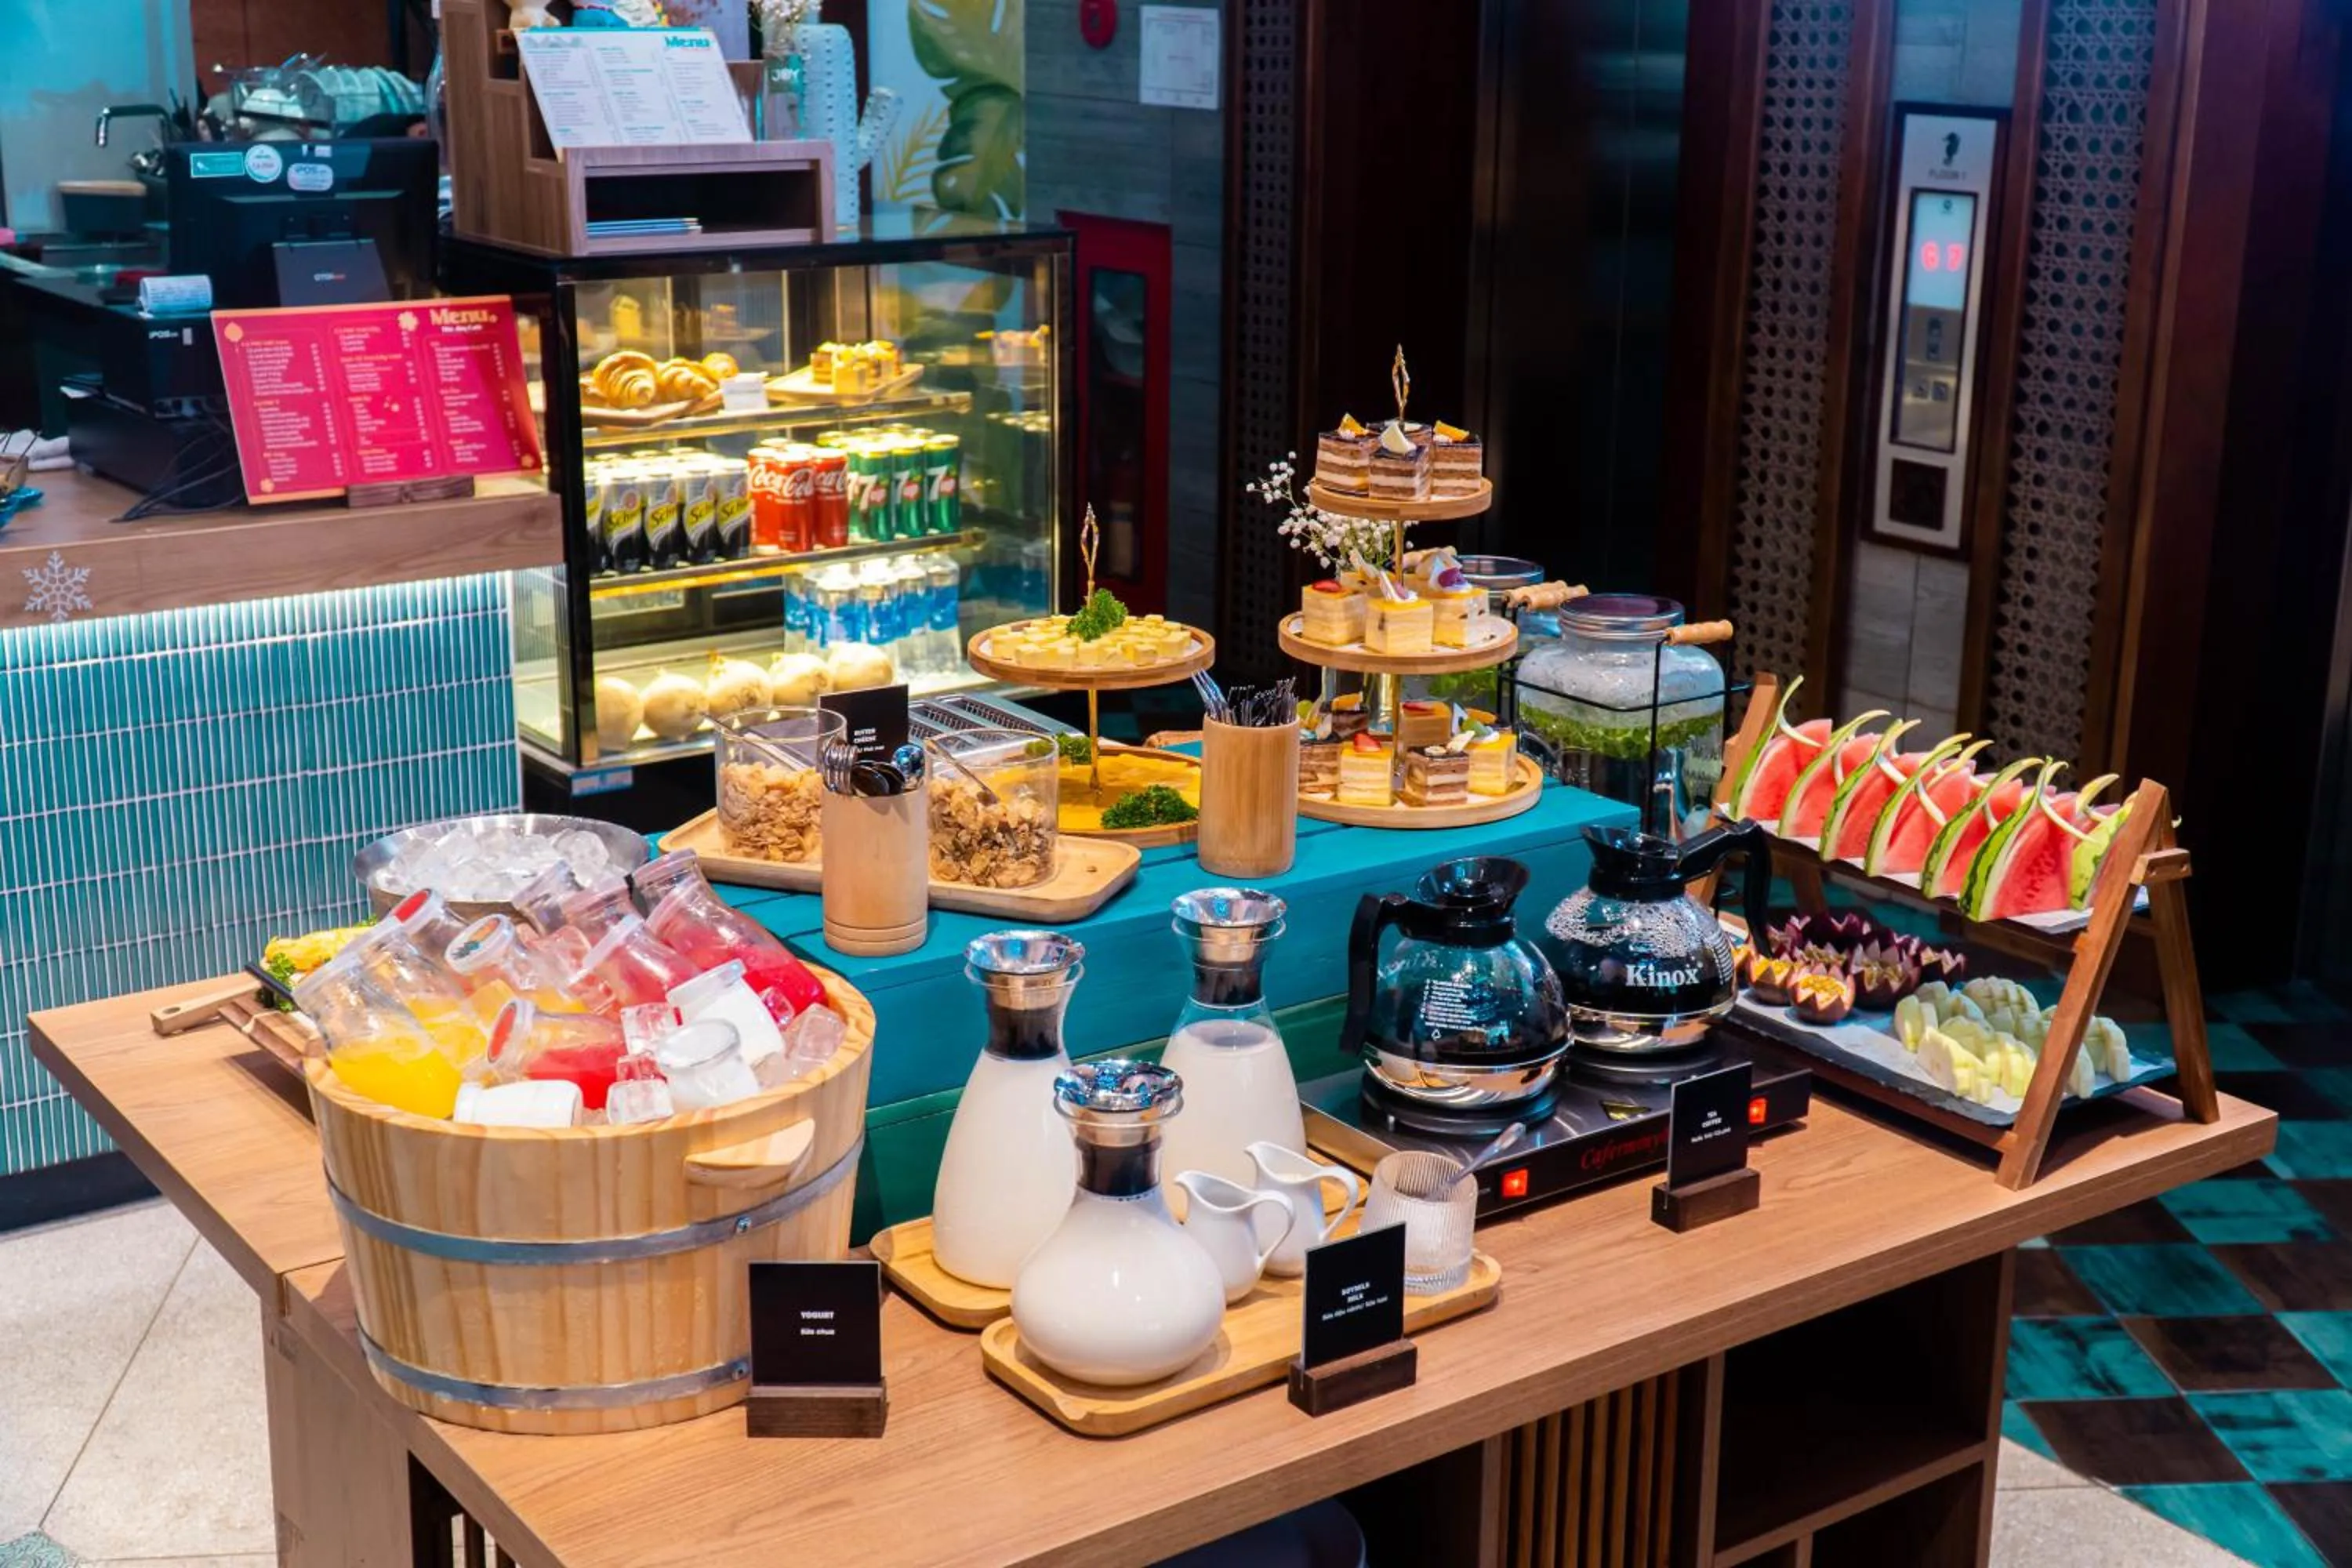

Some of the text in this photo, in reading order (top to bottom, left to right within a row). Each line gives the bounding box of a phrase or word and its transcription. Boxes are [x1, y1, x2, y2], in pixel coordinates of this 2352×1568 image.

[664, 36, 711, 48] Menu
[430, 308, 488, 326] Menu
[1625, 962, 1700, 987] Kinox
[800, 1311, 834, 1319] YOGURT
